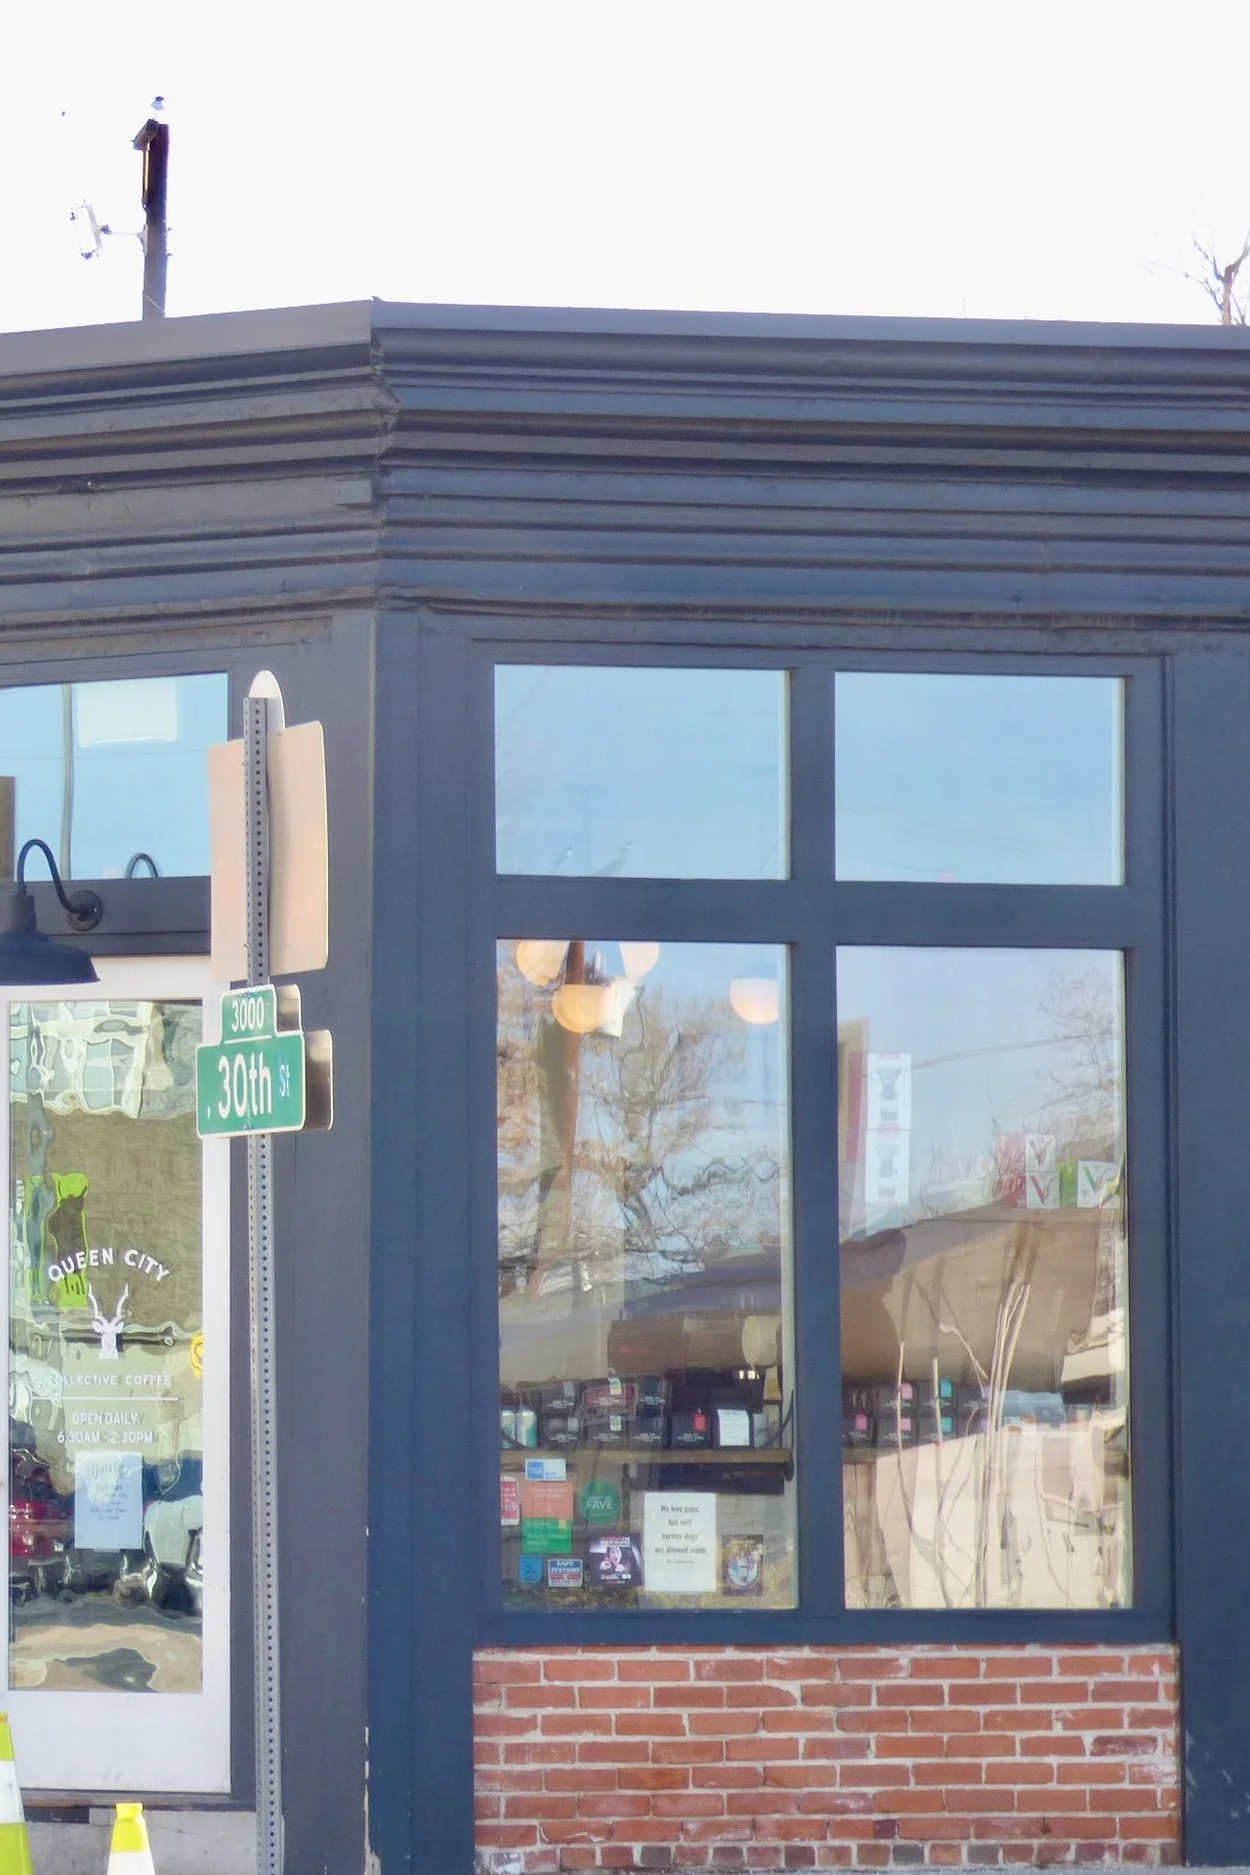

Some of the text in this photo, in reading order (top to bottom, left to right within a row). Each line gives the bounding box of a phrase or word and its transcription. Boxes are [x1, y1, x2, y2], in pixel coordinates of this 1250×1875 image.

[231, 996, 265, 1032] 3000
[217, 1052, 291, 1119] 30th St
[48, 1248, 170, 1282] QUEEN CITY
[125, 1375, 171, 1386] COFFEE
[72, 1412, 139, 1425] OPEN DAILY
[586, 1499, 614, 1510] FAVE
